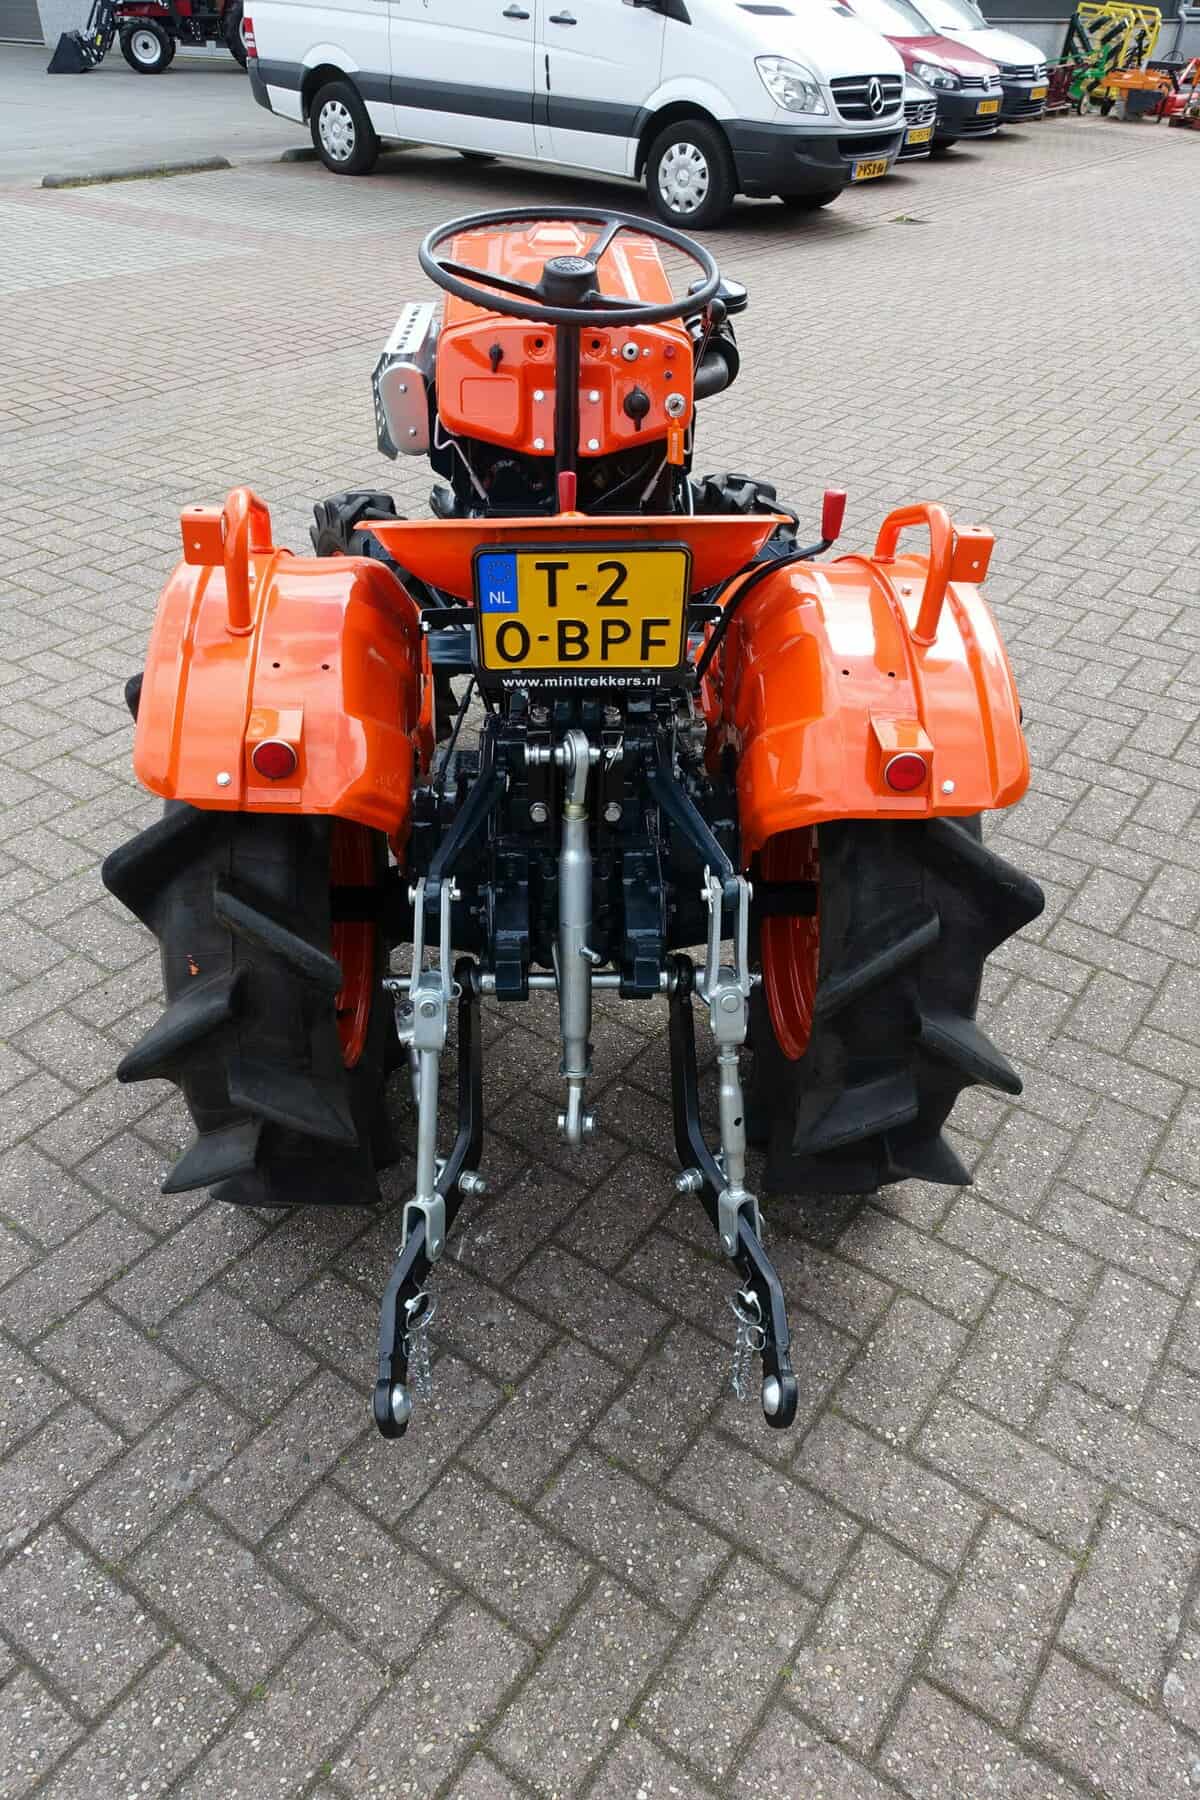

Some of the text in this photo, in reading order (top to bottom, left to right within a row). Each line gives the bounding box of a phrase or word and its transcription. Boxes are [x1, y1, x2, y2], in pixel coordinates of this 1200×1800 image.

[535, 560, 628, 607] T-2
[489, 591, 511, 604] NL
[502, 675, 661, 687] www.minitrekkers.nl
